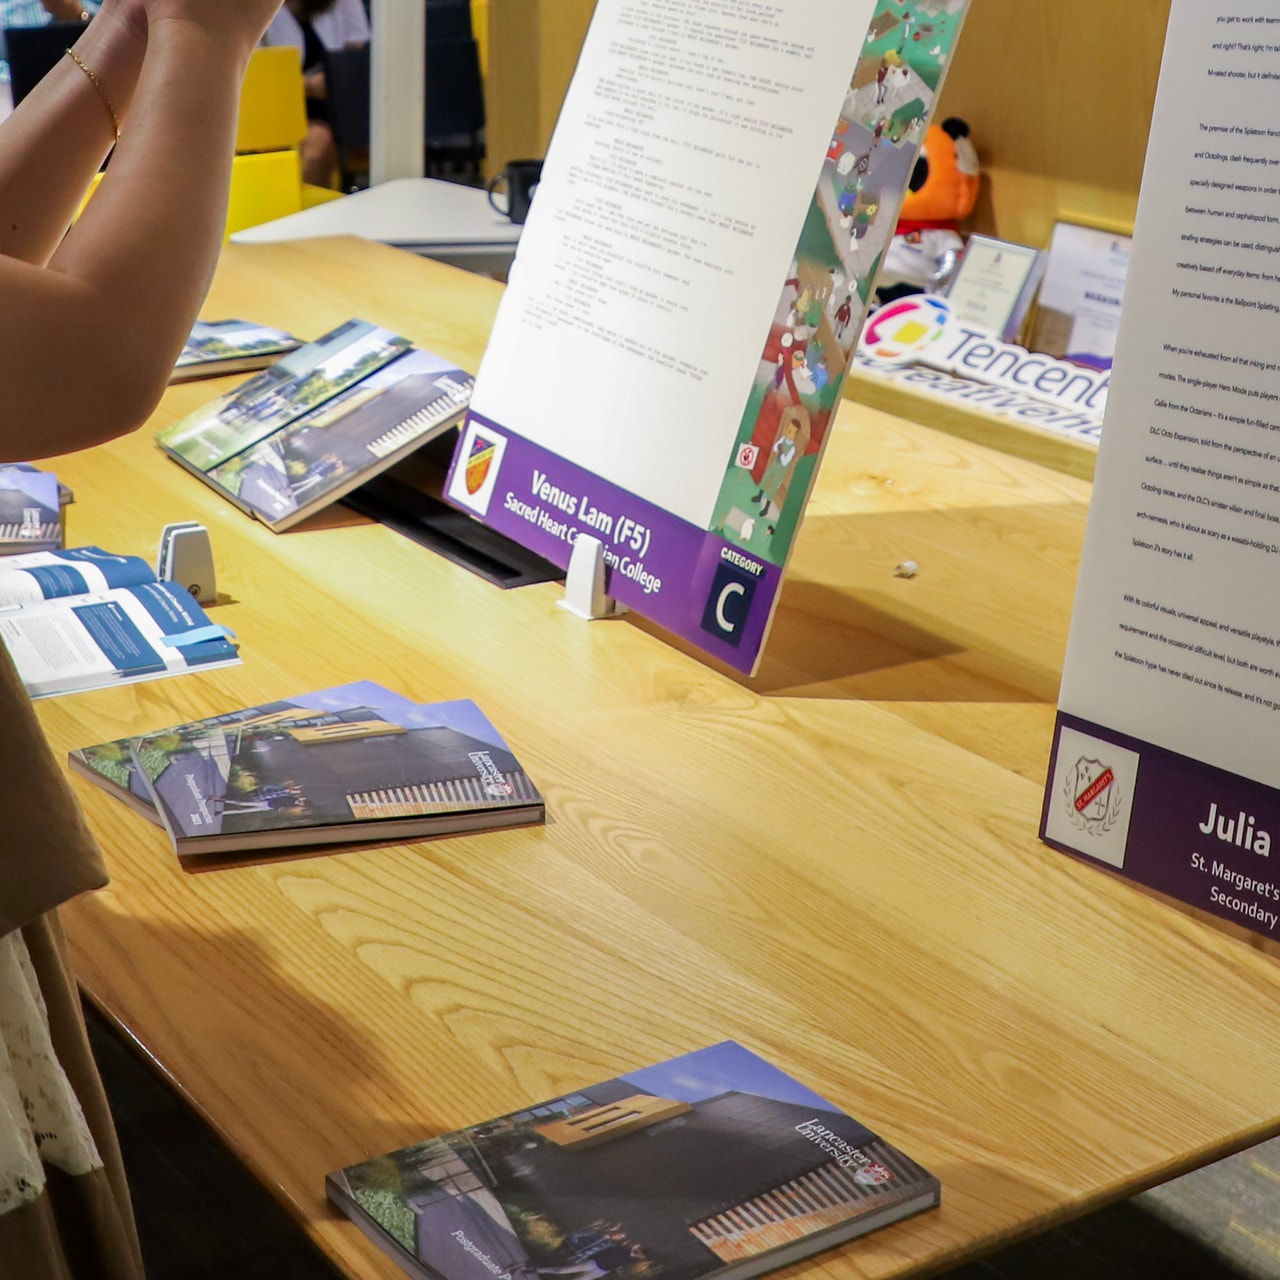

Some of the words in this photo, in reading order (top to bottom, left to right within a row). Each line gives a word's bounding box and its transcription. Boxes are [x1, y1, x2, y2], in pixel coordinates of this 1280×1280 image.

[1247, 71, 1257, 79] but
[946, 328, 1110, 408] Tencent
[531, 470, 578, 515] Venus
[578, 496, 613, 536] Lam
[613, 516, 652, 559] (F5)
[503, 491, 539, 523] Sacred
[537, 512, 569, 540] Heart
[619, 557, 662, 595] College
[720, 546, 764, 577] CATEGORY
[715, 581, 746, 633] C
[1123, 594, 1135, 603] With
[1141, 600, 1160, 611] colorful
[1177, 612, 1199, 623] universal
[1218, 624, 1230, 632] and
[1229, 627, 1251, 638] versatile
[1114, 650, 1123, 658] the
[1123, 652, 1144, 665] Splatoon
[1144, 659, 1157, 670] hype
[1158, 663, 1167, 673] has
[1167, 668, 1181, 677] never
[1181, 672, 1194, 682] died
[1193, 677, 1203, 685] out
[1203, 680, 1217, 689] since
[1243, 693, 1255, 702] and
[1262, 699, 1273, 708] not
[1198, 802, 1271, 858] Julia
[1190, 851, 1208, 874] St.
[1211, 859, 1280, 902] Margaret's
[1210, 885, 1277, 931] Secondary
[795, 1121, 858, 1167] University
[804, 1118, 872, 1166] Lancaster
[451, 1230, 502, 1277] Postgraduate
